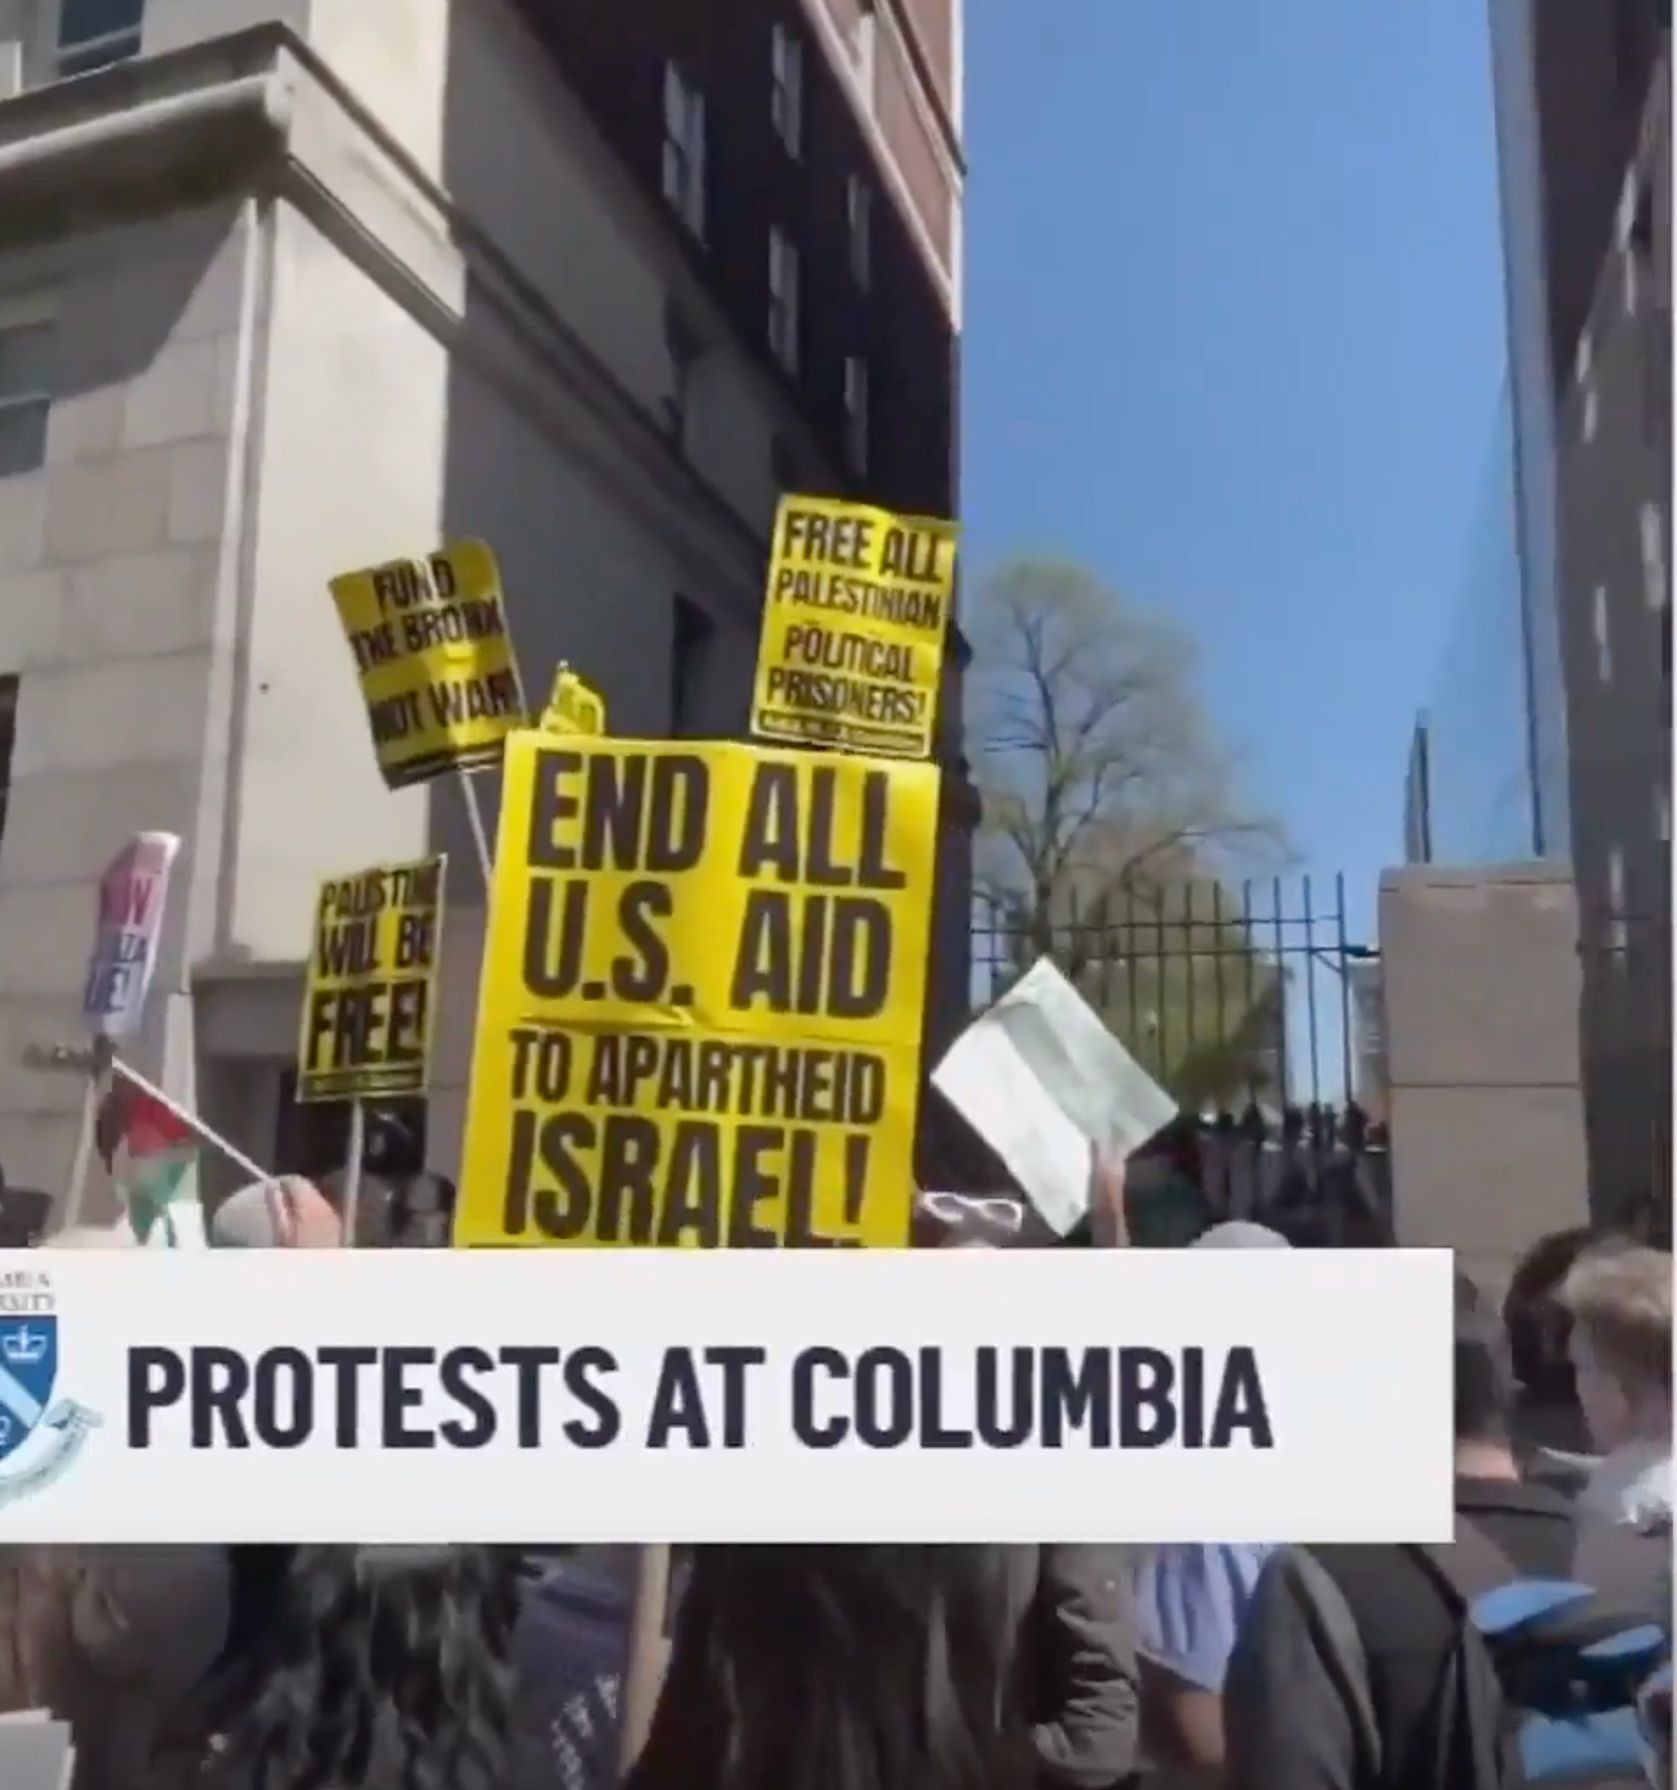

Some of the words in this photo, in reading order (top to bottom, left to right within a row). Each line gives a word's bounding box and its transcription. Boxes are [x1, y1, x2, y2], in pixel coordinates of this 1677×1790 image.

[782, 511, 875, 569] FREE
[878, 527, 945, 583] ALL
[774, 568, 942, 631] PALESTINIAN
[783, 624, 915, 684] POLITICAL
[766, 668, 928, 727] PRISONERS!
[527, 747, 710, 872] END
[737, 761, 906, 890] ALL
[523, 876, 695, 1007] U.S.
[729, 889, 892, 1019] AID
[508, 1028, 572, 1102] TO
[586, 1033, 886, 1125] APARTHEID
[502, 1109, 872, 1248] ISRAEL!
